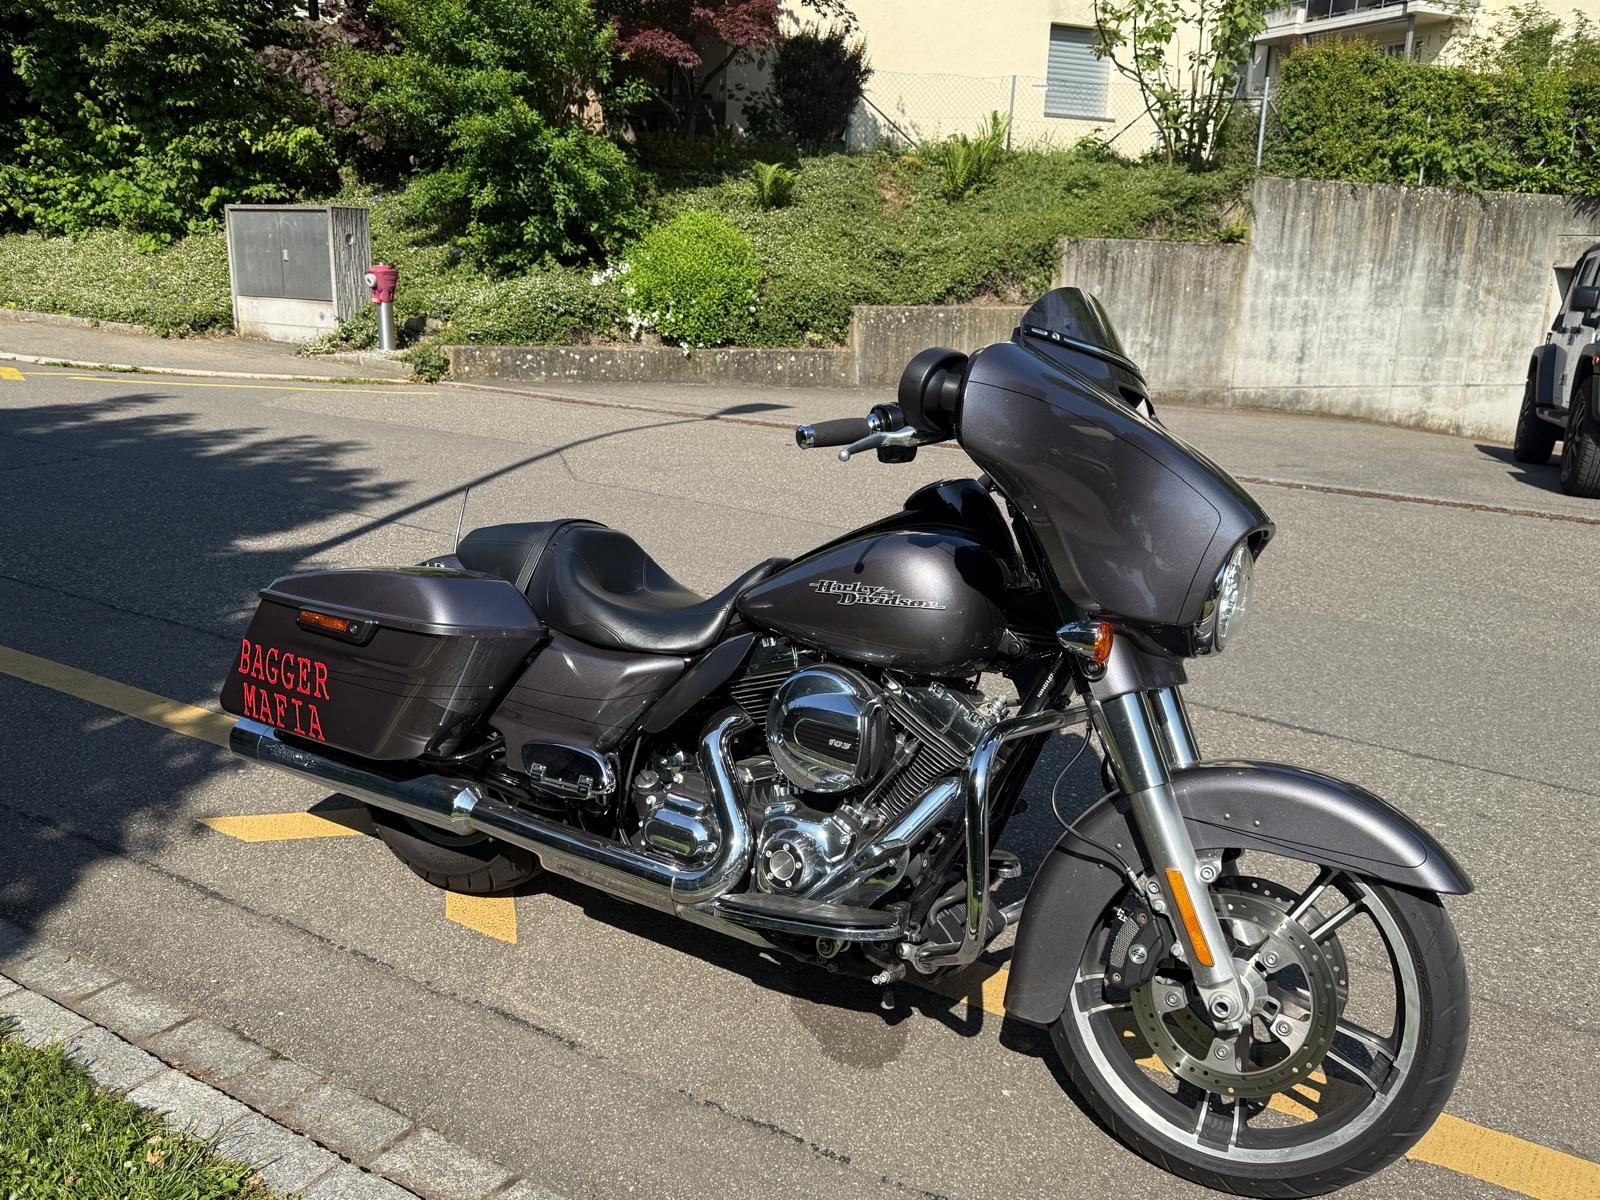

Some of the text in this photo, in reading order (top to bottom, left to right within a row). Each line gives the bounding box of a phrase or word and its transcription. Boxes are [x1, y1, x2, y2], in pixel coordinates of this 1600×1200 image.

[809, 579, 894, 597] Harley
[837, 592, 946, 610] Davidson
[238, 638, 330, 701] BAGGER
[243, 682, 325, 742] MAFIA
